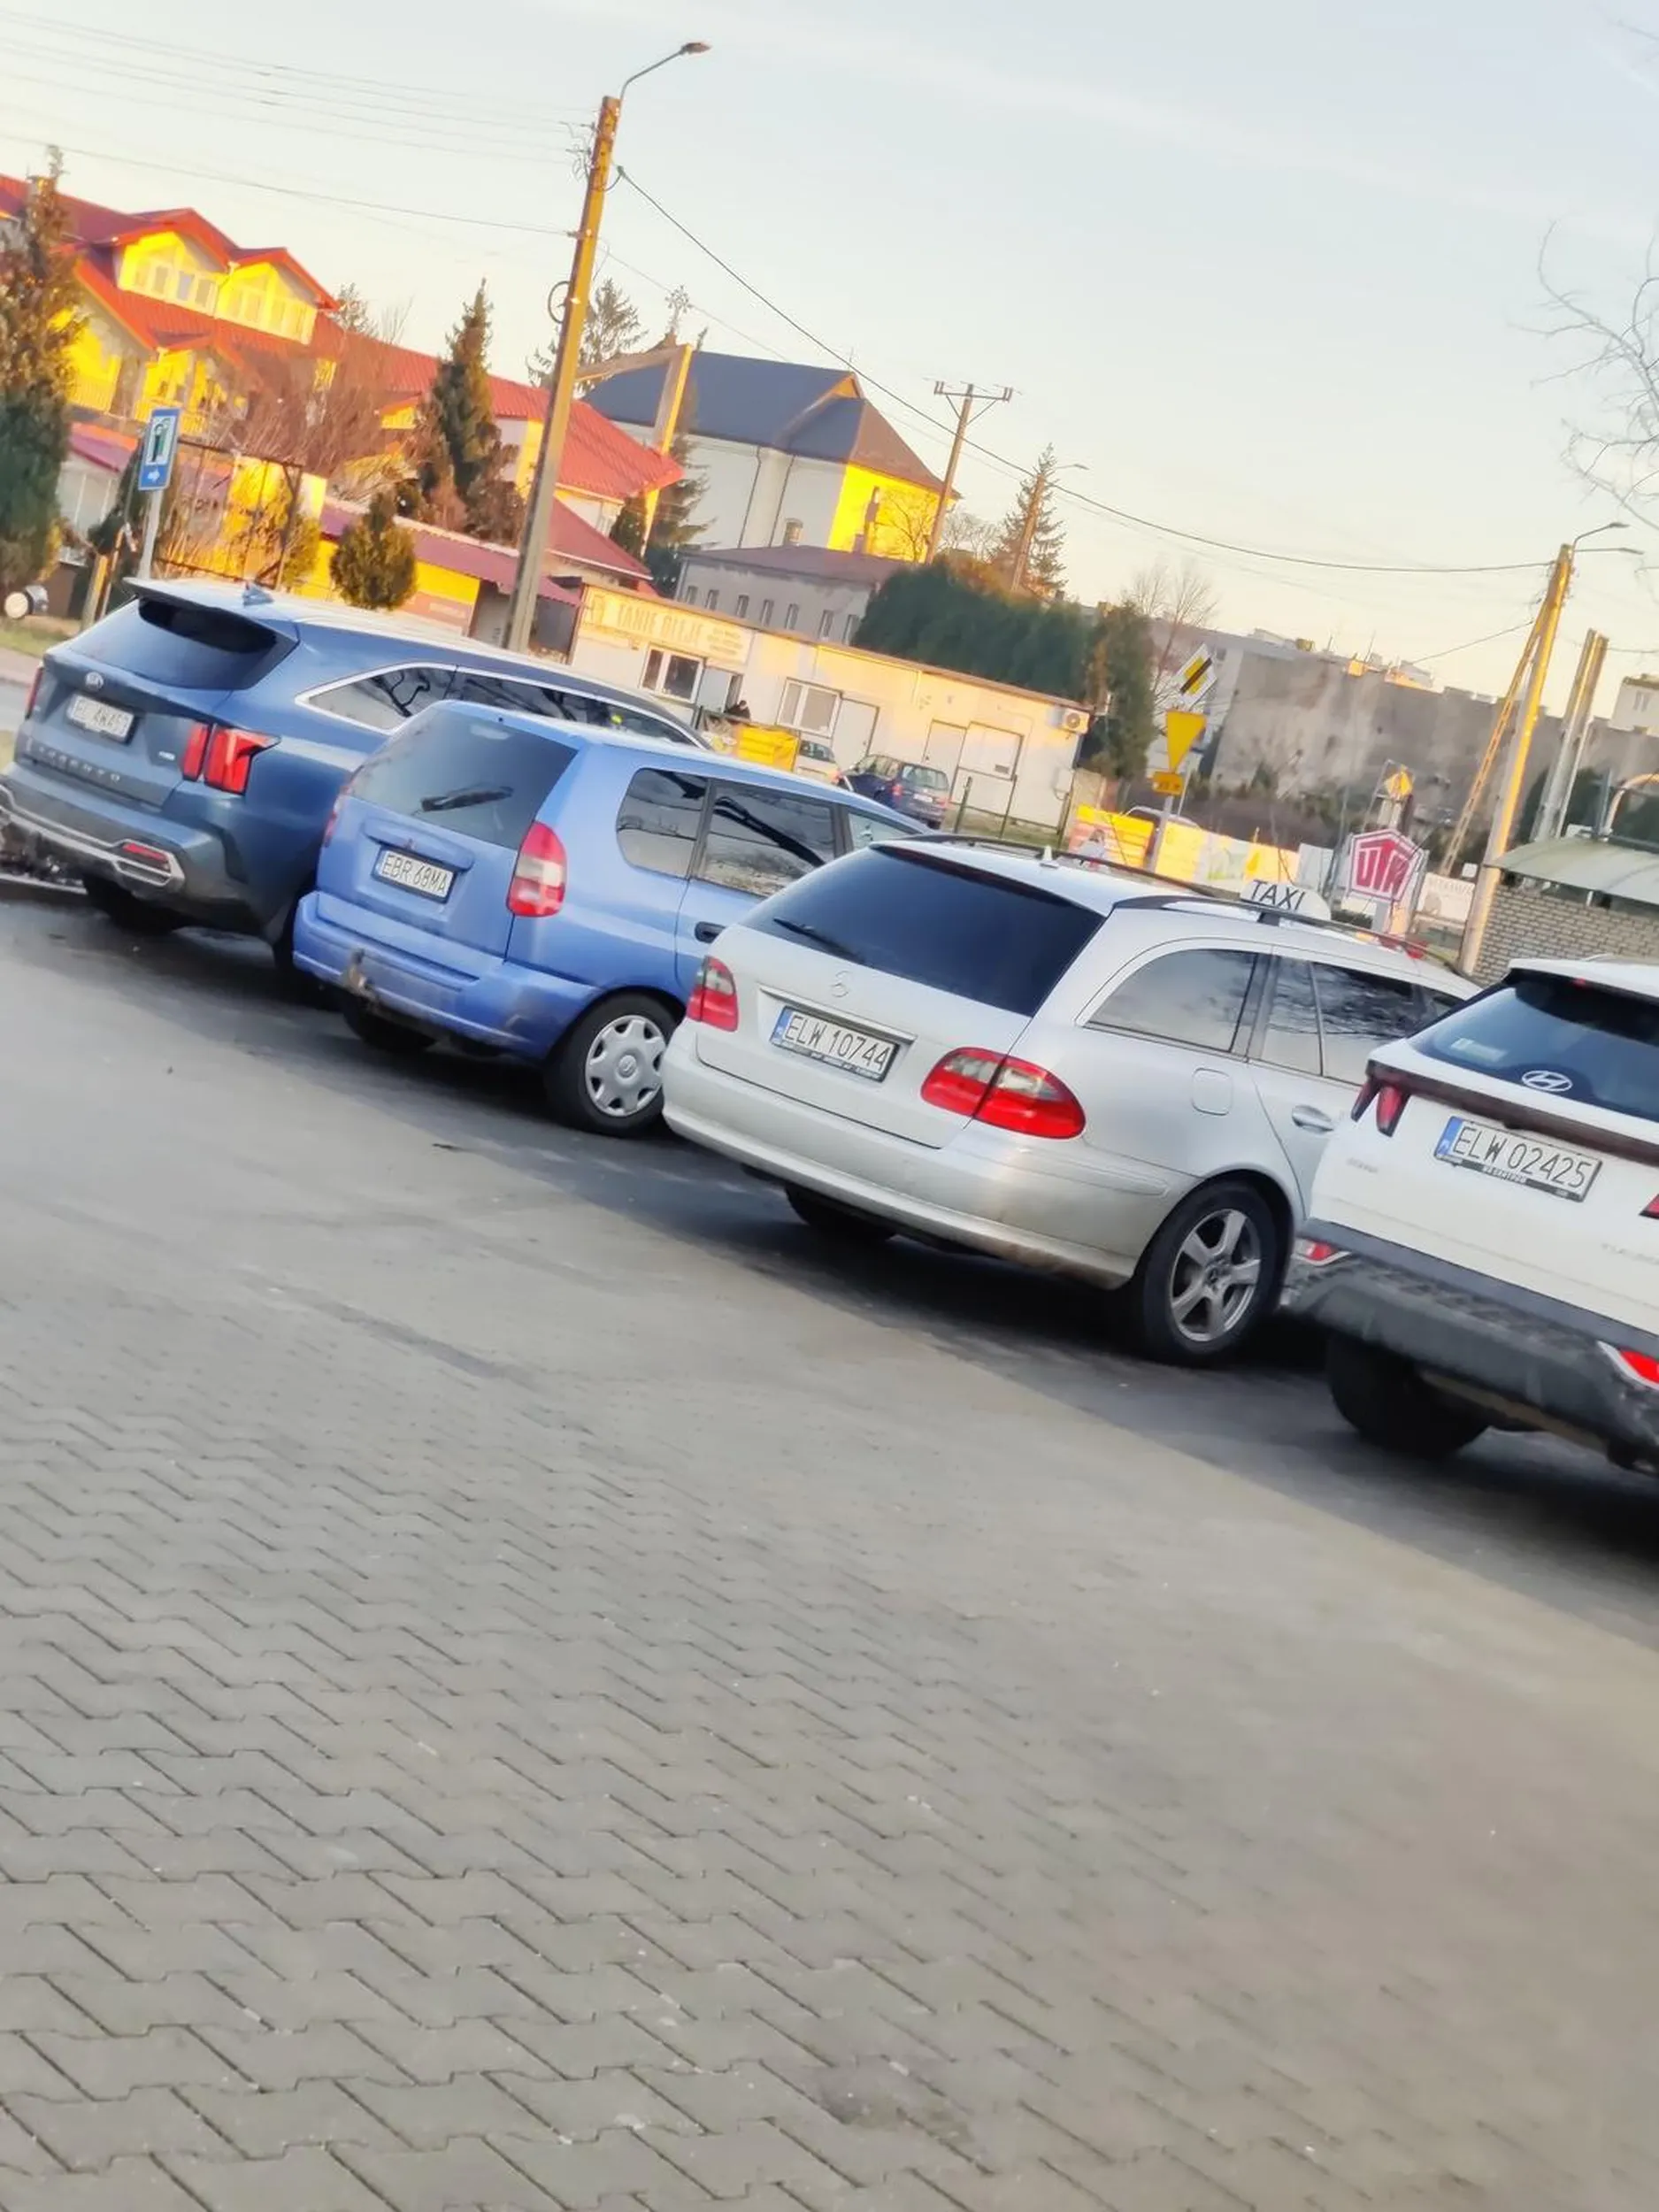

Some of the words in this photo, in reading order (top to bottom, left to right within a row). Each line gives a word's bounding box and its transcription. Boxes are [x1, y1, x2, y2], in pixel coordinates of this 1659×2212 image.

[381, 854, 412, 882] EBR
[1250, 879, 1307, 910] TAXI
[784, 1014, 827, 1048] ELW
[828, 1030, 891, 1071] 10744
[1452, 1125, 1508, 1164] ELW
[1506, 1142, 1593, 1189] 02425
